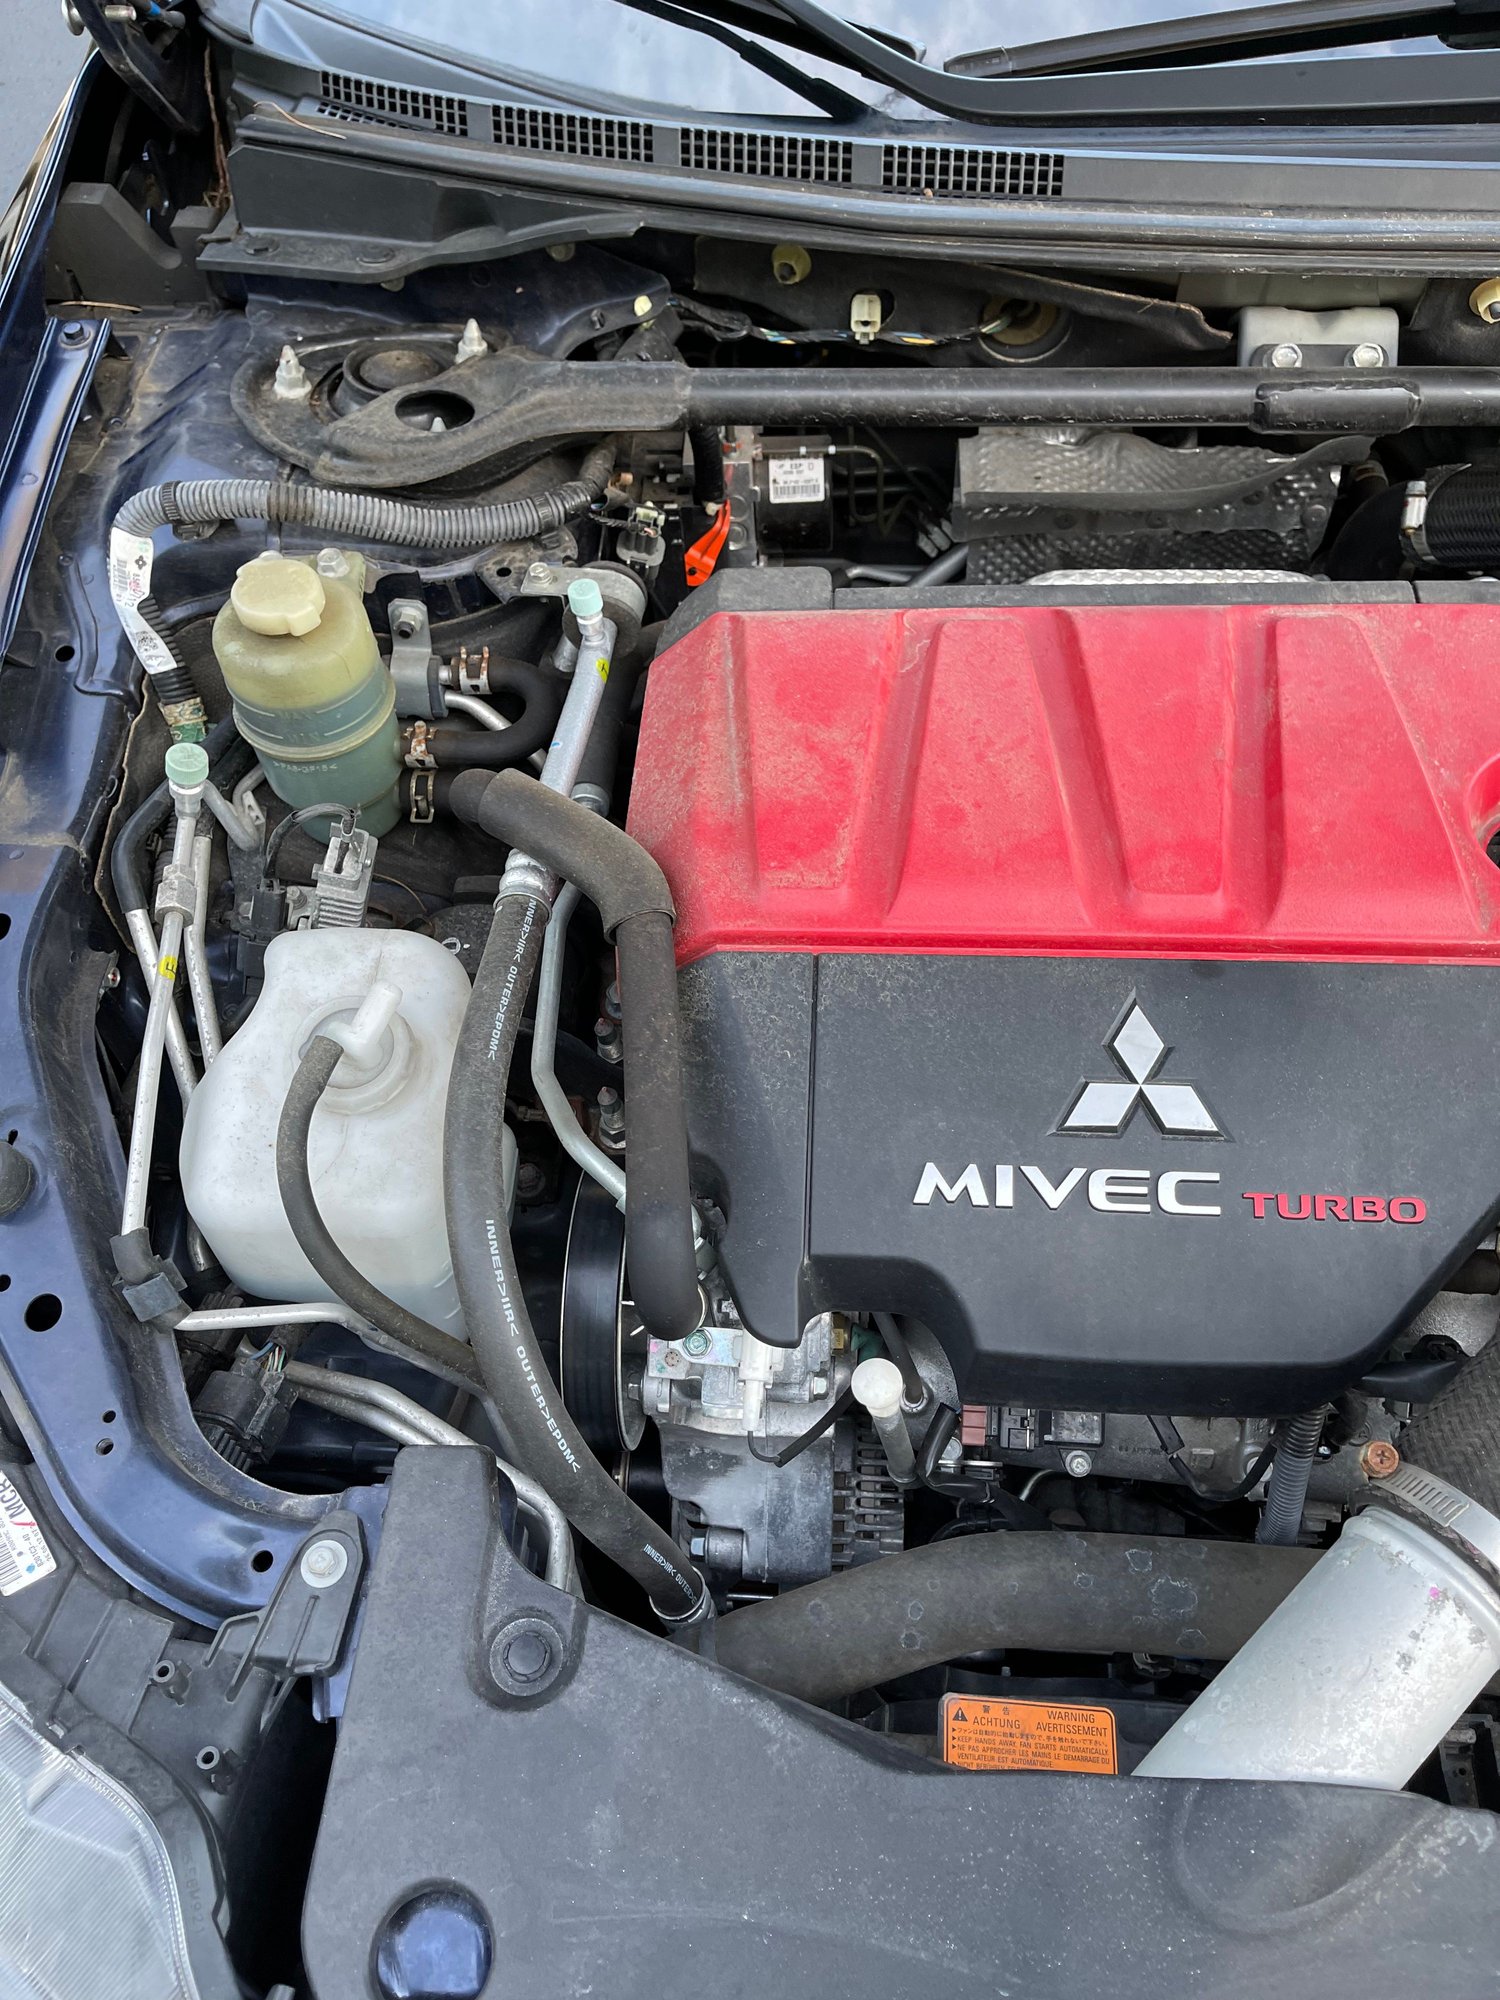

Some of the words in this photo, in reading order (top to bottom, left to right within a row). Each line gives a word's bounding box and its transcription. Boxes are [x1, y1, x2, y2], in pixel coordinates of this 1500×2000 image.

[912, 1161, 1221, 1216] MIVEC
[1242, 1192, 1428, 1224] TURBO
[485, 1219, 520, 1337] INNER>IIR<
[972, 1715, 1021, 1730] ACHTUNG
[1047, 1710, 1095, 1724] WARNING
[1036, 1721, 1108, 1737] AVERTISSEMENT
[957, 1735, 972, 1743] KEEP
[975, 1737, 996, 1746] HANDS
[1019, 1741, 1032, 1750] FAN
[1034, 1743, 1057, 1752] STARTS
[957, 1744, 966, 1752] NE
[968, 1745, 980, 1753] PAS
[981, 1747, 1017, 1757] APPROCHER
[1018, 1750, 1029, 1758] LES
[1031, 1750, 1052, 1760] MAINS
[1101, 1757, 1110, 1765] DU
[957, 1752, 996, 1763] VENTILATEUR
[997, 1756, 1009, 1764] EST
